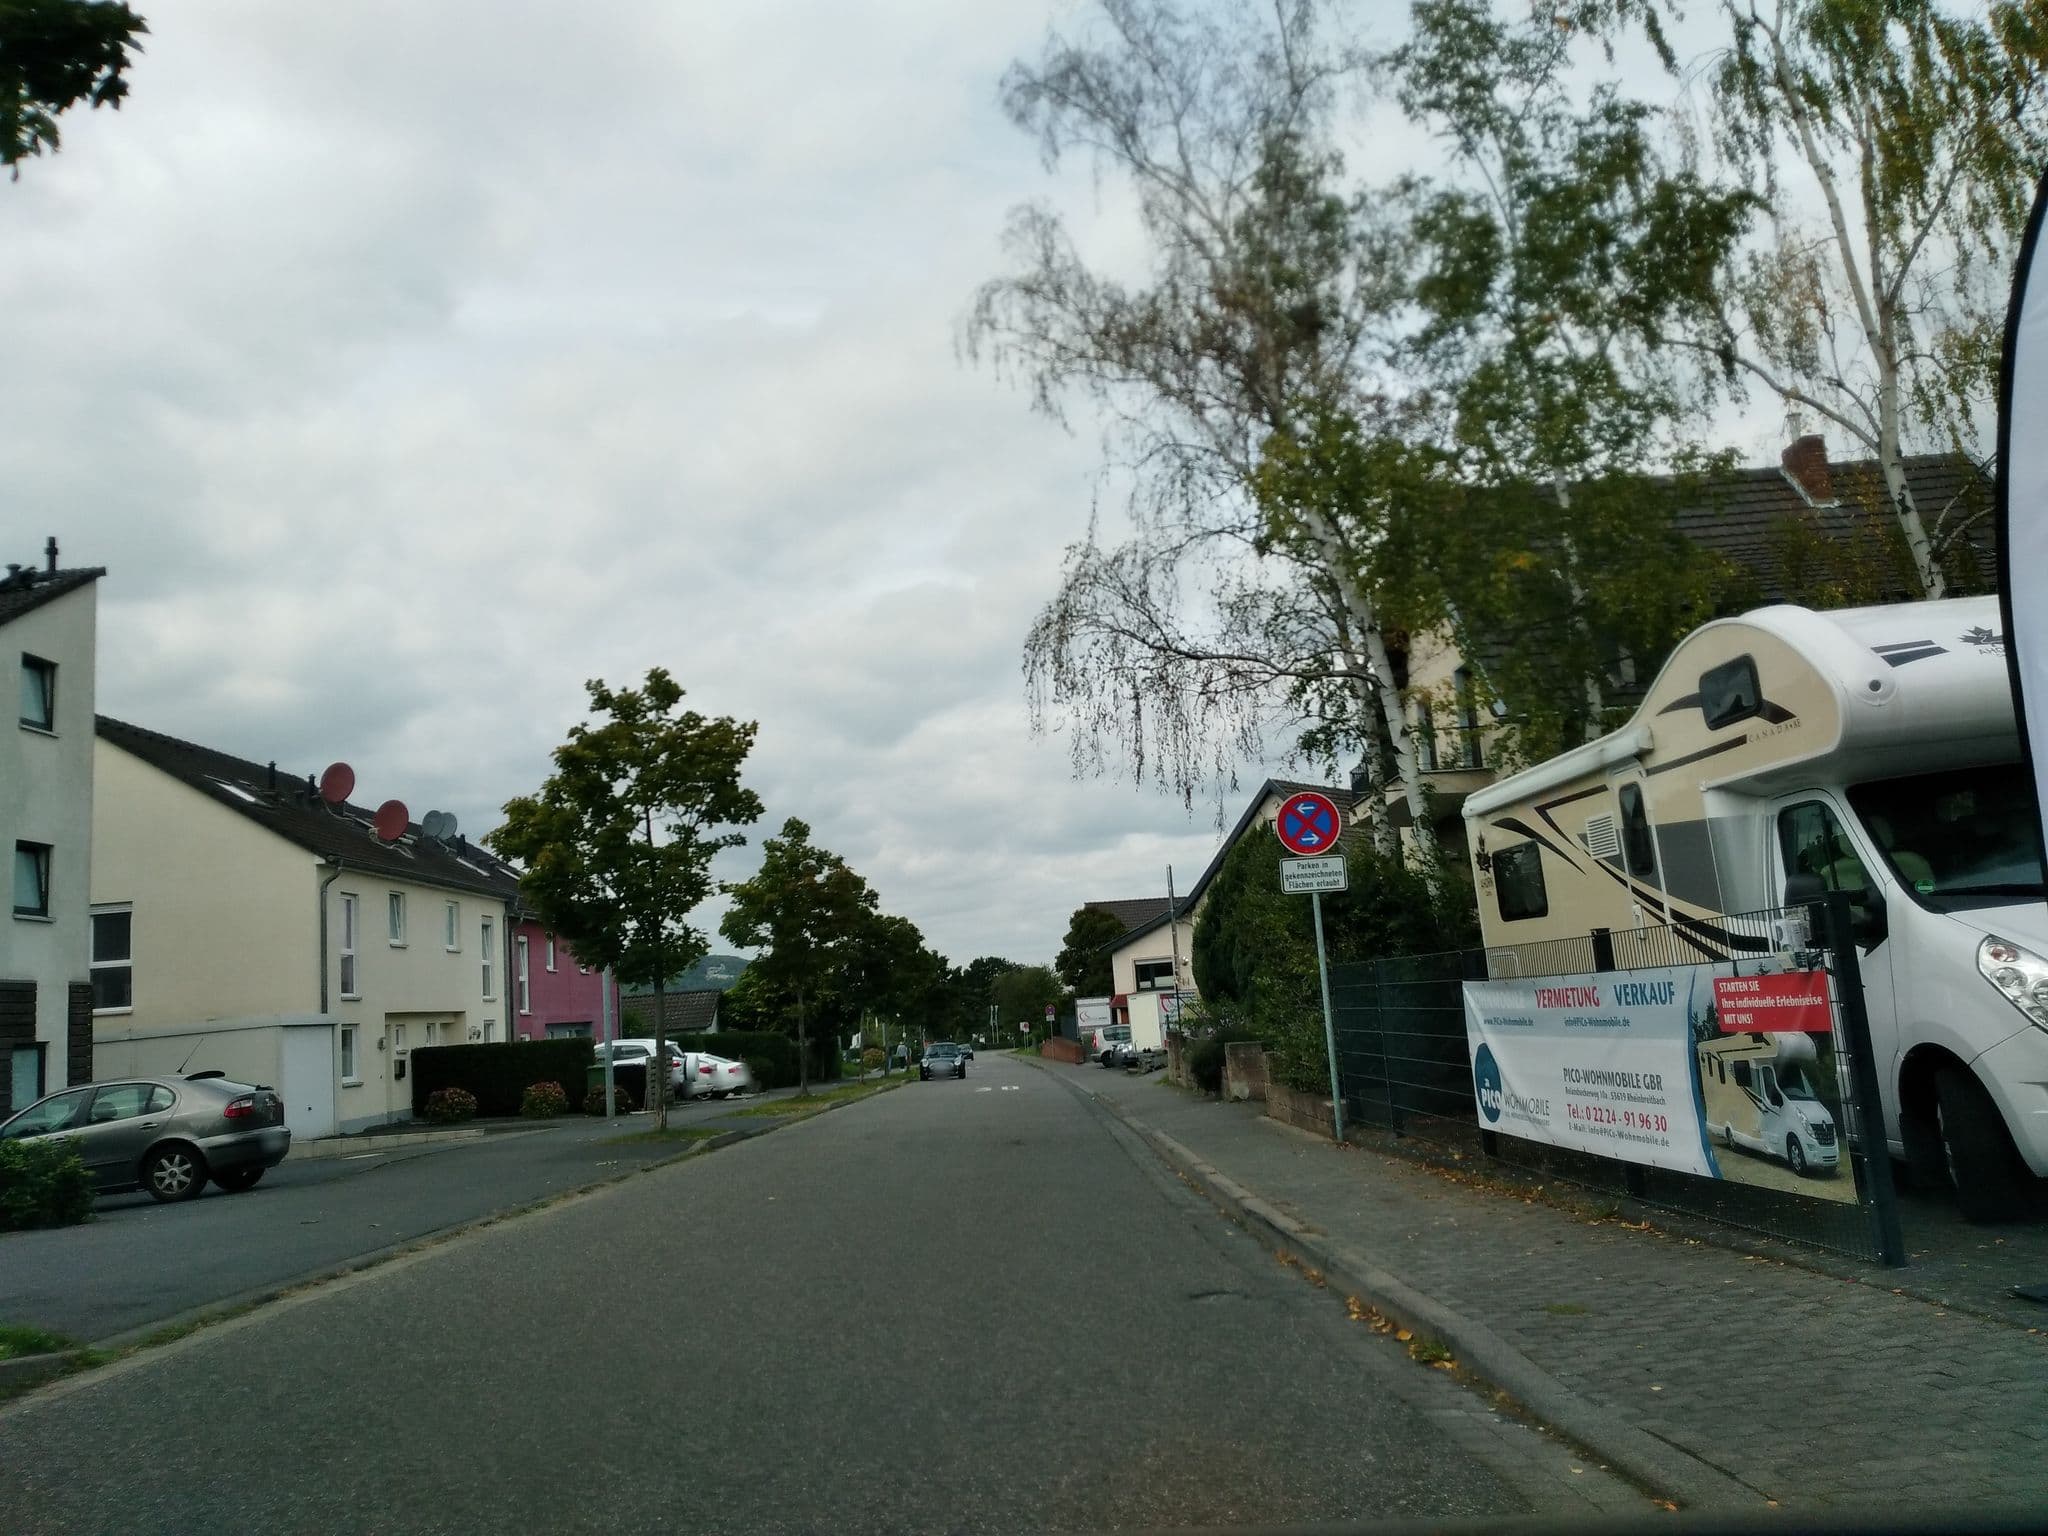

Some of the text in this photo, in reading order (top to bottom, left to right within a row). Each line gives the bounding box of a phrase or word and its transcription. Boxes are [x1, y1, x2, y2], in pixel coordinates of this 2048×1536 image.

[1297, 862, 1319, 870] Parken
[1284, 870, 1343, 882] gekennzeichneten
[1288, 879, 1340, 889] Flächen erlaubt
[1719, 980, 1760, 993] STARTEN SIE
[1534, 985, 1600, 1009] VERMIETUNG
[1613, 981, 1675, 1007] VERKAUF
[1736, 995, 1776, 1009] individuelle
[1723, 1013, 1754, 1025] MIT UNS!
[1563, 1067, 1663, 1092] PICO-WOHNMOBILE GBR
[1566, 1103, 1584, 1121] Tel.:
[1585, 1105, 1592, 1121] 0
[1593, 1106, 1605, 1123] 22
[1605, 1108, 1617, 1126] 24
[1623, 1110, 1636, 1128] 91
[1638, 1112, 1652, 1130] 96
[1653, 1114, 1668, 1133] 30
